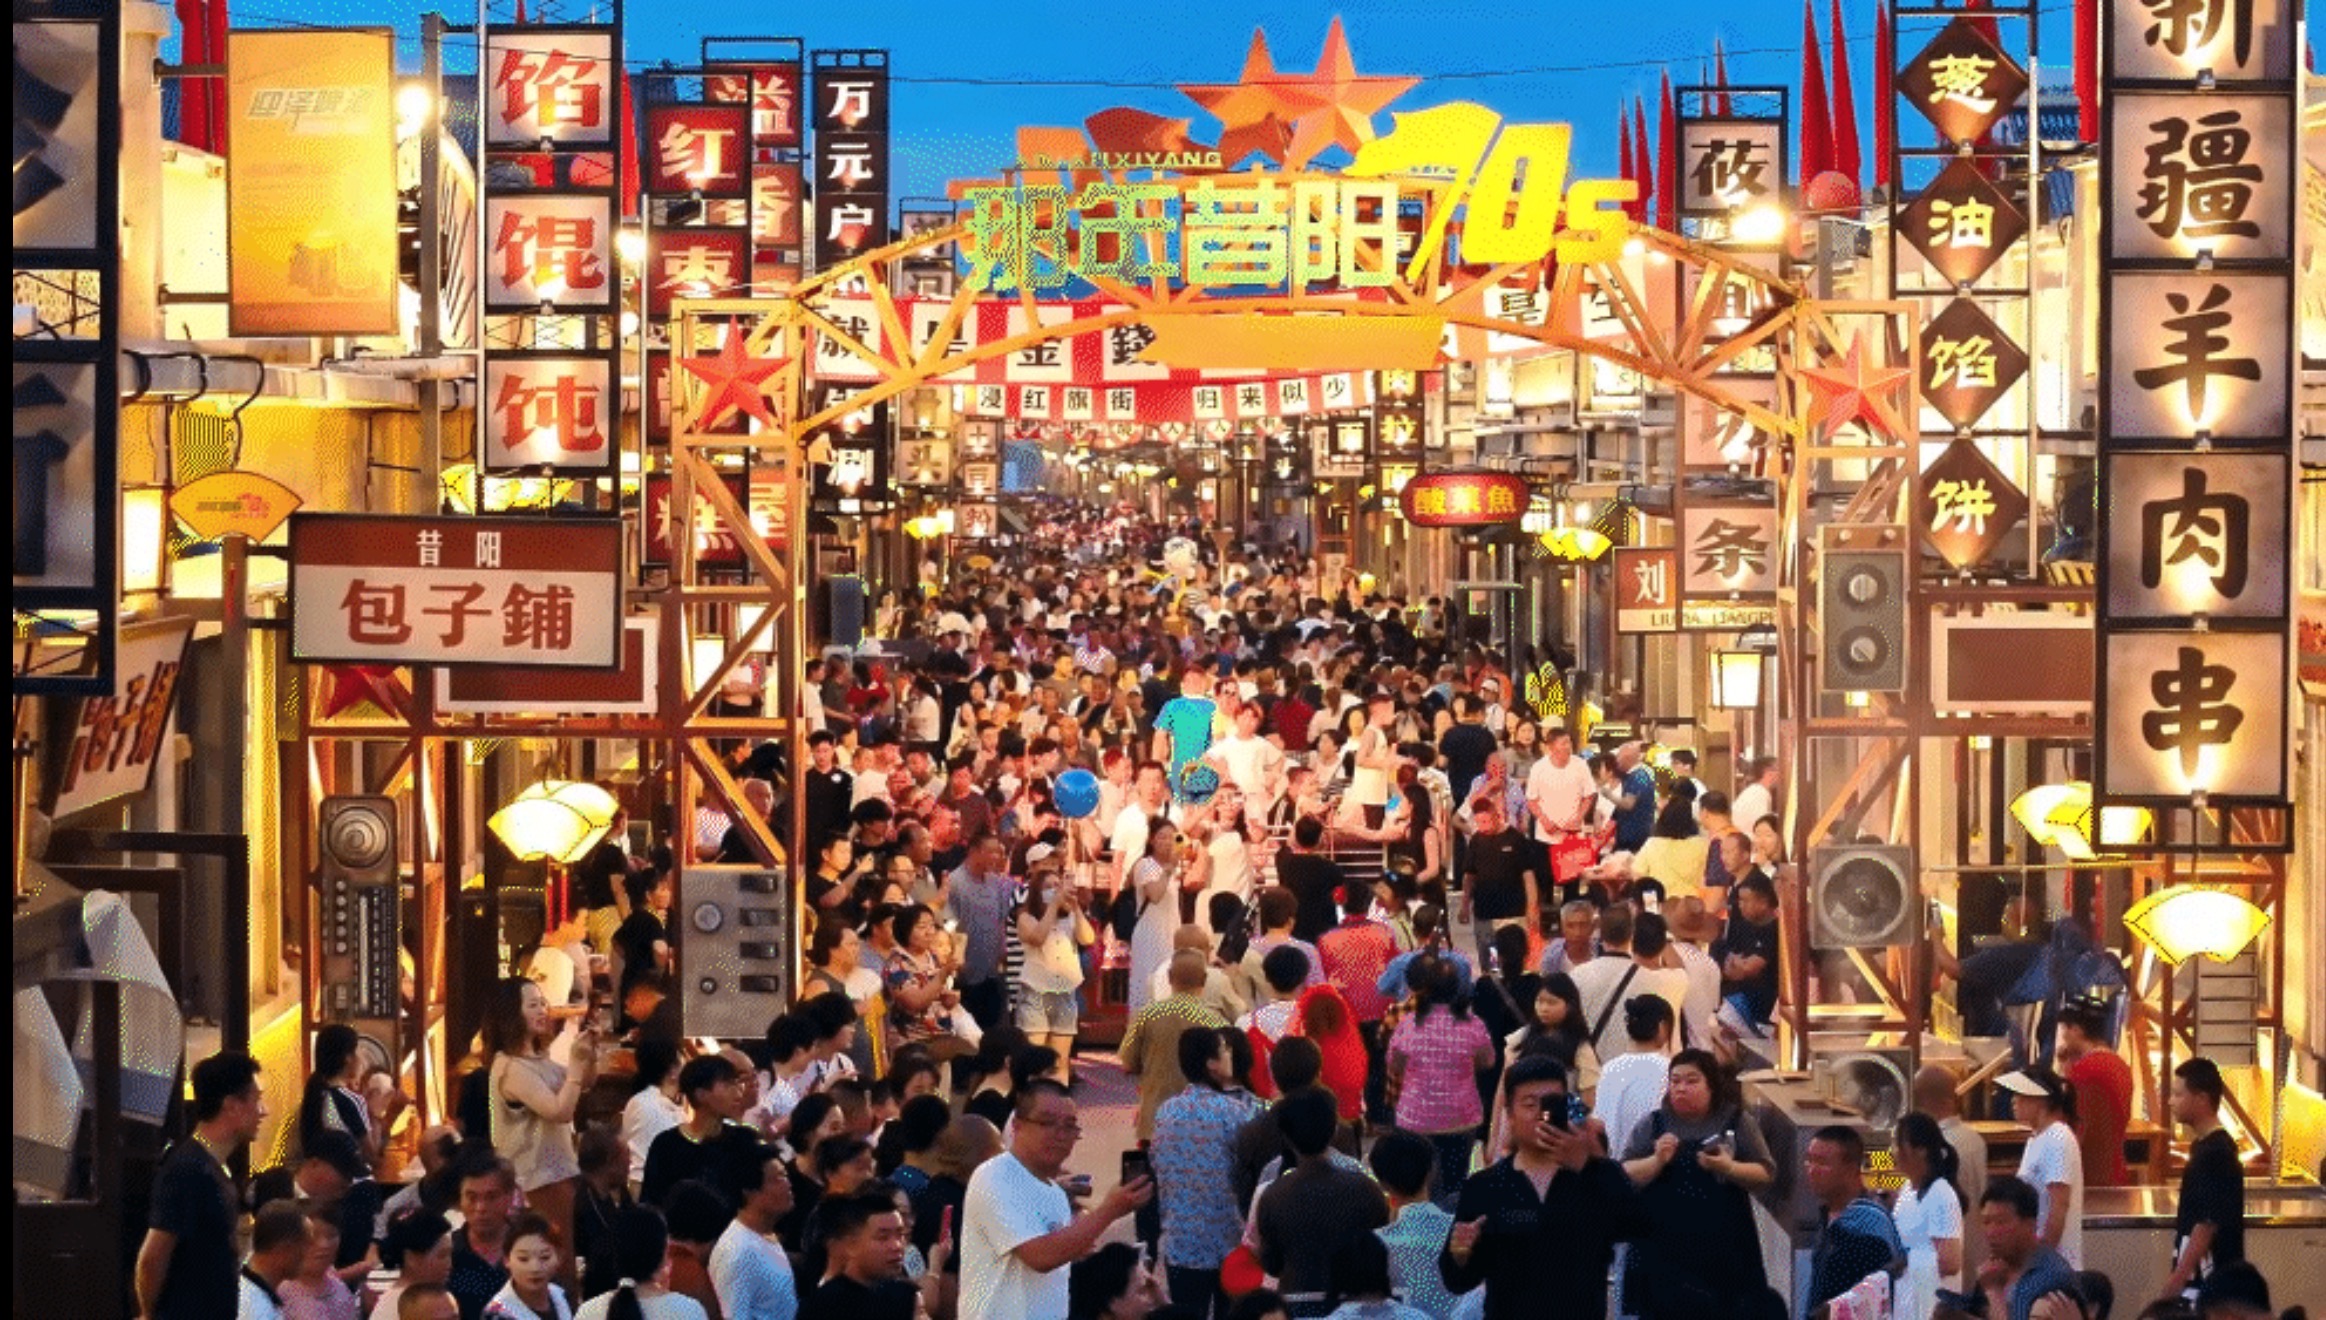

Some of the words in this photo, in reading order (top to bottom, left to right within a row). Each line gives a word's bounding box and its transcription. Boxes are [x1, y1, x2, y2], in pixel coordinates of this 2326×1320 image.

[495, 48, 605, 455] 馅馄饨
[1928, 53, 1998, 535] 葱油馅饼
[2133, 0, 2264, 777] 新疆羊肉串
[341, 578, 575, 650] 包子鋪
[417, 530, 501, 567] 昔阳
[1633, 559, 1666, 605] 刘
